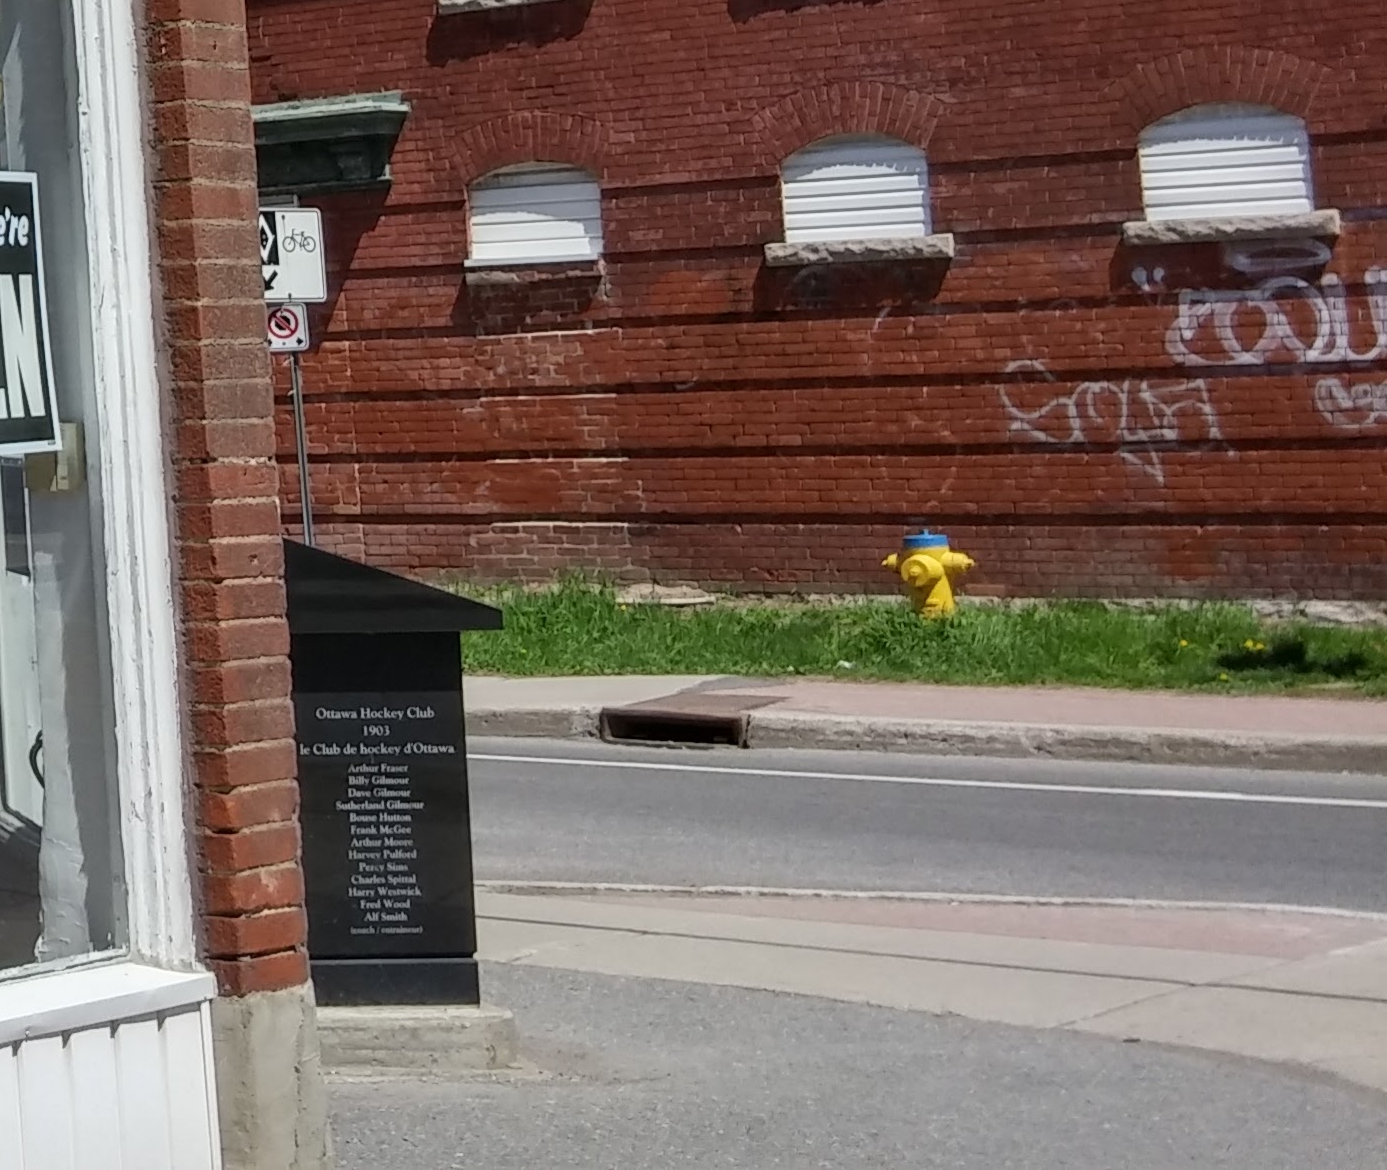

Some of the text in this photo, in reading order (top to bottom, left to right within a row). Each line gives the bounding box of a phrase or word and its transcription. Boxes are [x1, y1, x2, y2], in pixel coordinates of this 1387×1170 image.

[315, 706, 435, 720] Ottawa Hockey Club
[363, 725, 390, 736] 1903
[313, 743, 341, 755] Club
[343, 743, 358, 755] de
[359, 742, 402, 756] hockey
[403, 742, 456, 755] d'Ottawa
[372, 775, 410, 785] Gilmour
[348, 788, 411, 798] Dave Gilmour
[386, 800, 424, 810] Gilmour
